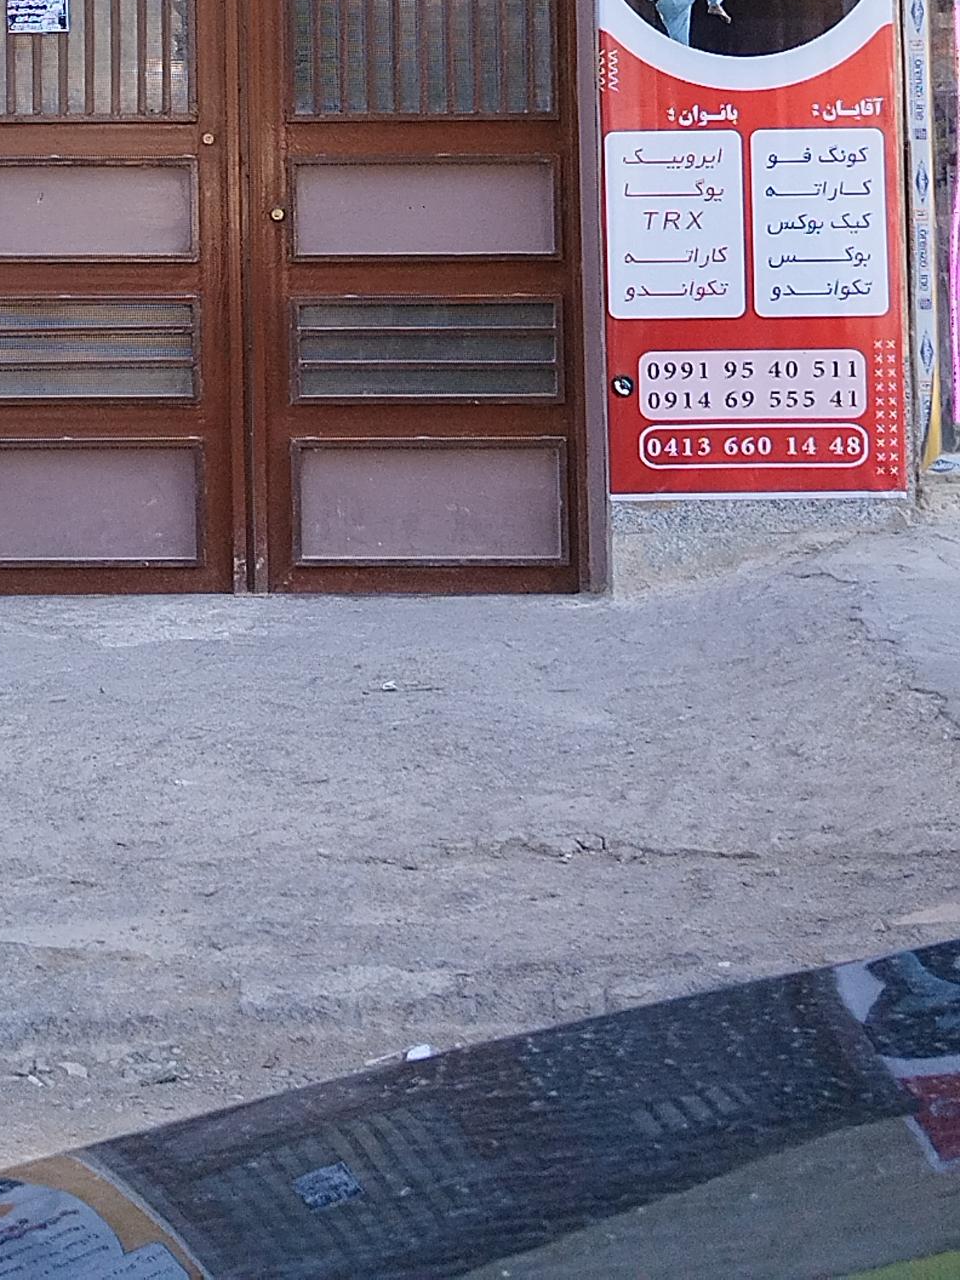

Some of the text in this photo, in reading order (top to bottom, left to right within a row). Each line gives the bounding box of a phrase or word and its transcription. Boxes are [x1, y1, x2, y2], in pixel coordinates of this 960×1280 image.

[622, 147, 722, 170] ایروبیک
[766, 145, 869, 170] کونگ فو
[624, 179, 725, 203] یوگا
[765, 179, 872, 201] کاراته
[643, 211, 704, 230] TRX
[767, 212, 872, 235] کیک بوکس
[624, 246, 728, 268] کاراته
[768, 245, 871, 268] بوکس
[624, 279, 728, 302] تکواندو
[770, 279, 872, 301] تکواندو
[647, 360, 857, 380] 0991 95 40 511
[648, 390, 858, 409] 0914 69 555 41
[647, 436, 861, 457] 0413 660 14 48
